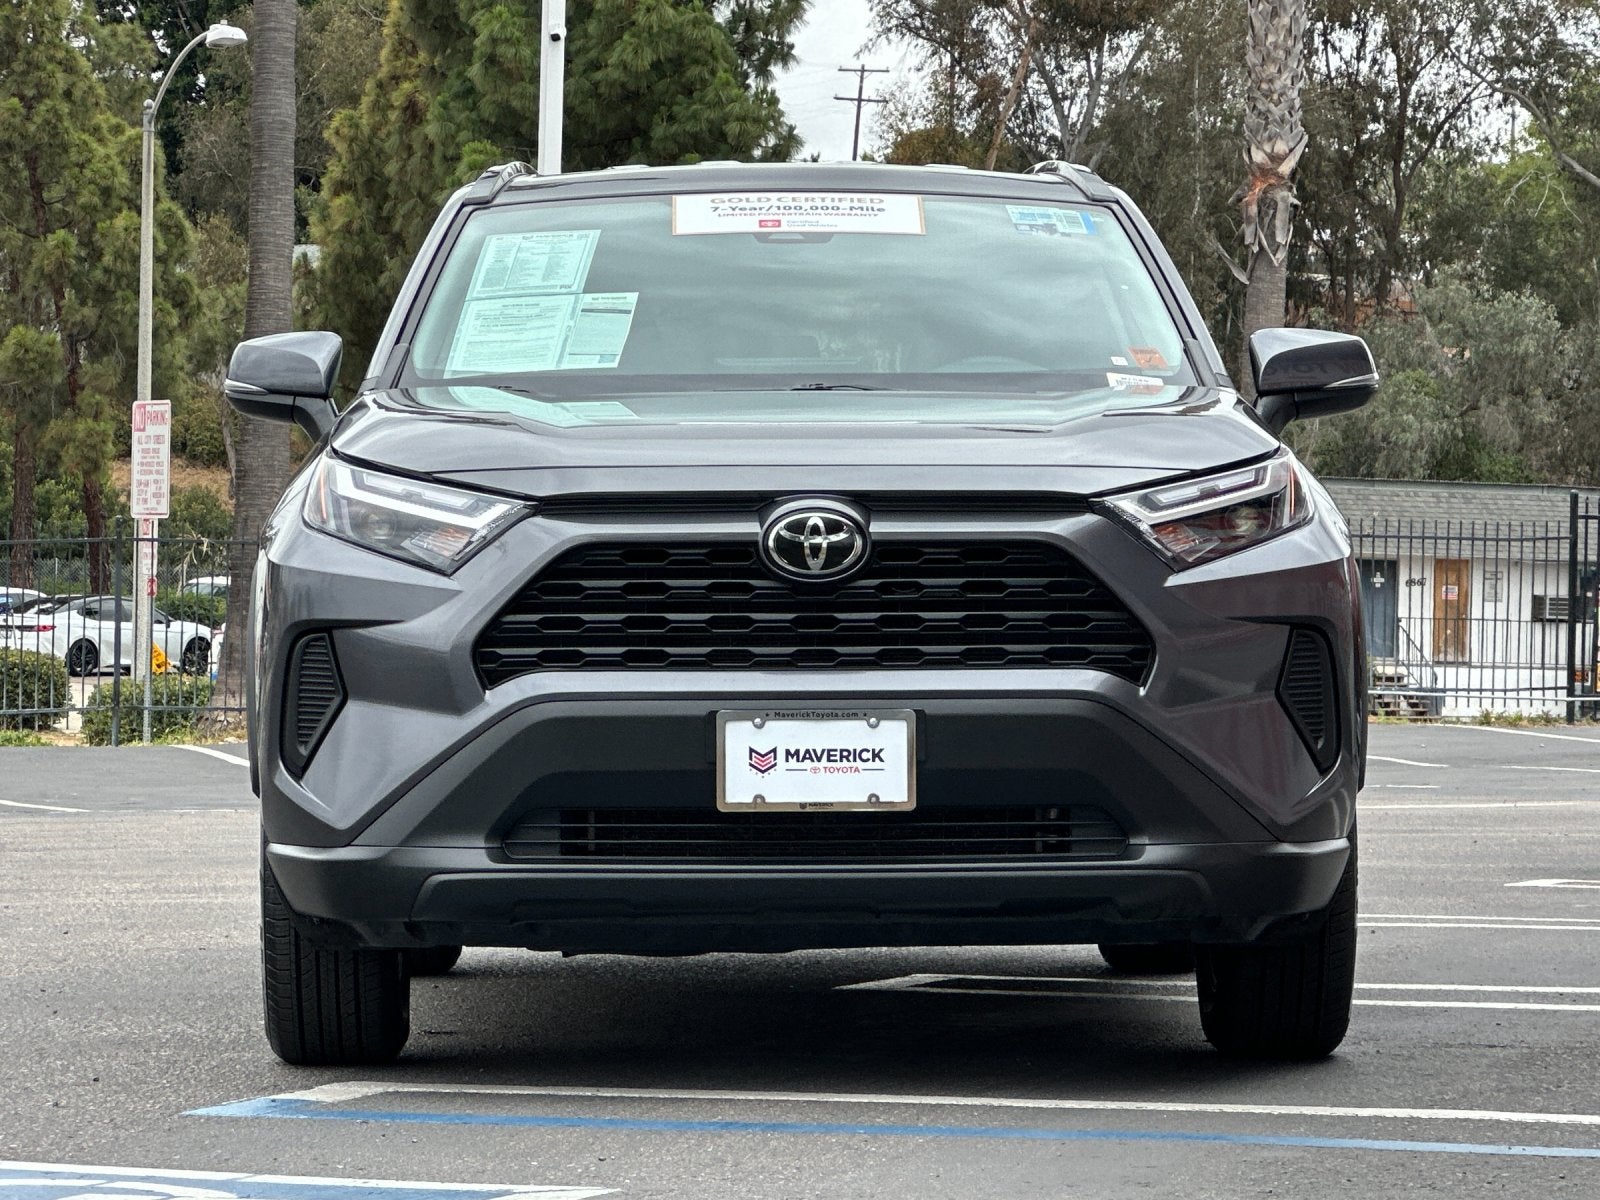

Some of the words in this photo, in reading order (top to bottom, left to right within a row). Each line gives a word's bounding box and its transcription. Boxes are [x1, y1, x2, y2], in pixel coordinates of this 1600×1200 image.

[710, 196, 772, 204] GOLD
[776, 196, 885, 204] CERTIFIED
[785, 748, 885, 763] MAVERICK
[823, 766, 861, 774] TOYOTA
